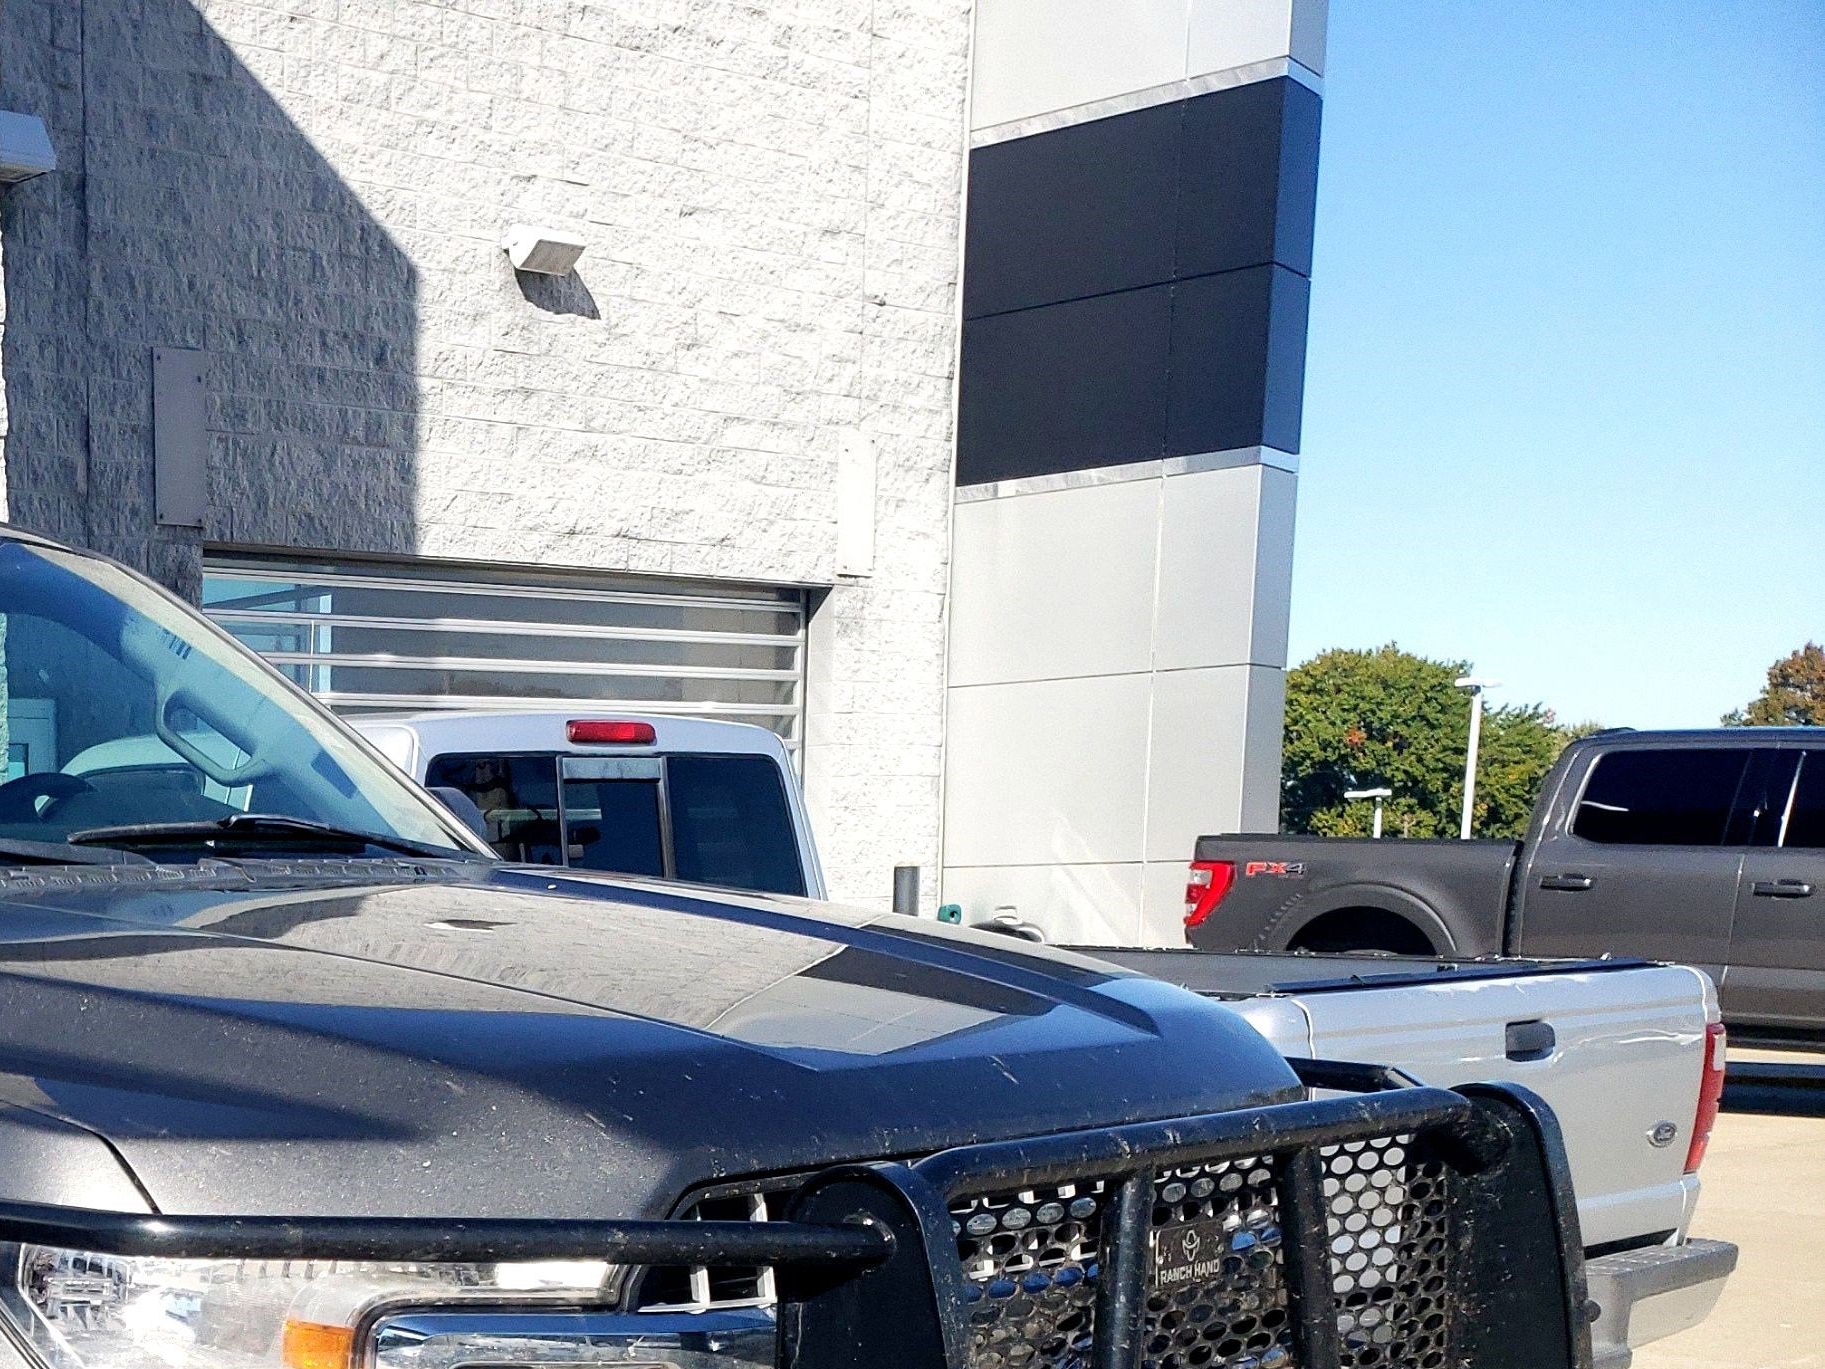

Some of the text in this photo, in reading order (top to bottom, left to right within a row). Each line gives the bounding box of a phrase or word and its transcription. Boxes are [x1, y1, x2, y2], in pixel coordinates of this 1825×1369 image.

[1245, 861, 1307, 876] FX4
[1160, 1259, 1221, 1285] RANCH HAND
